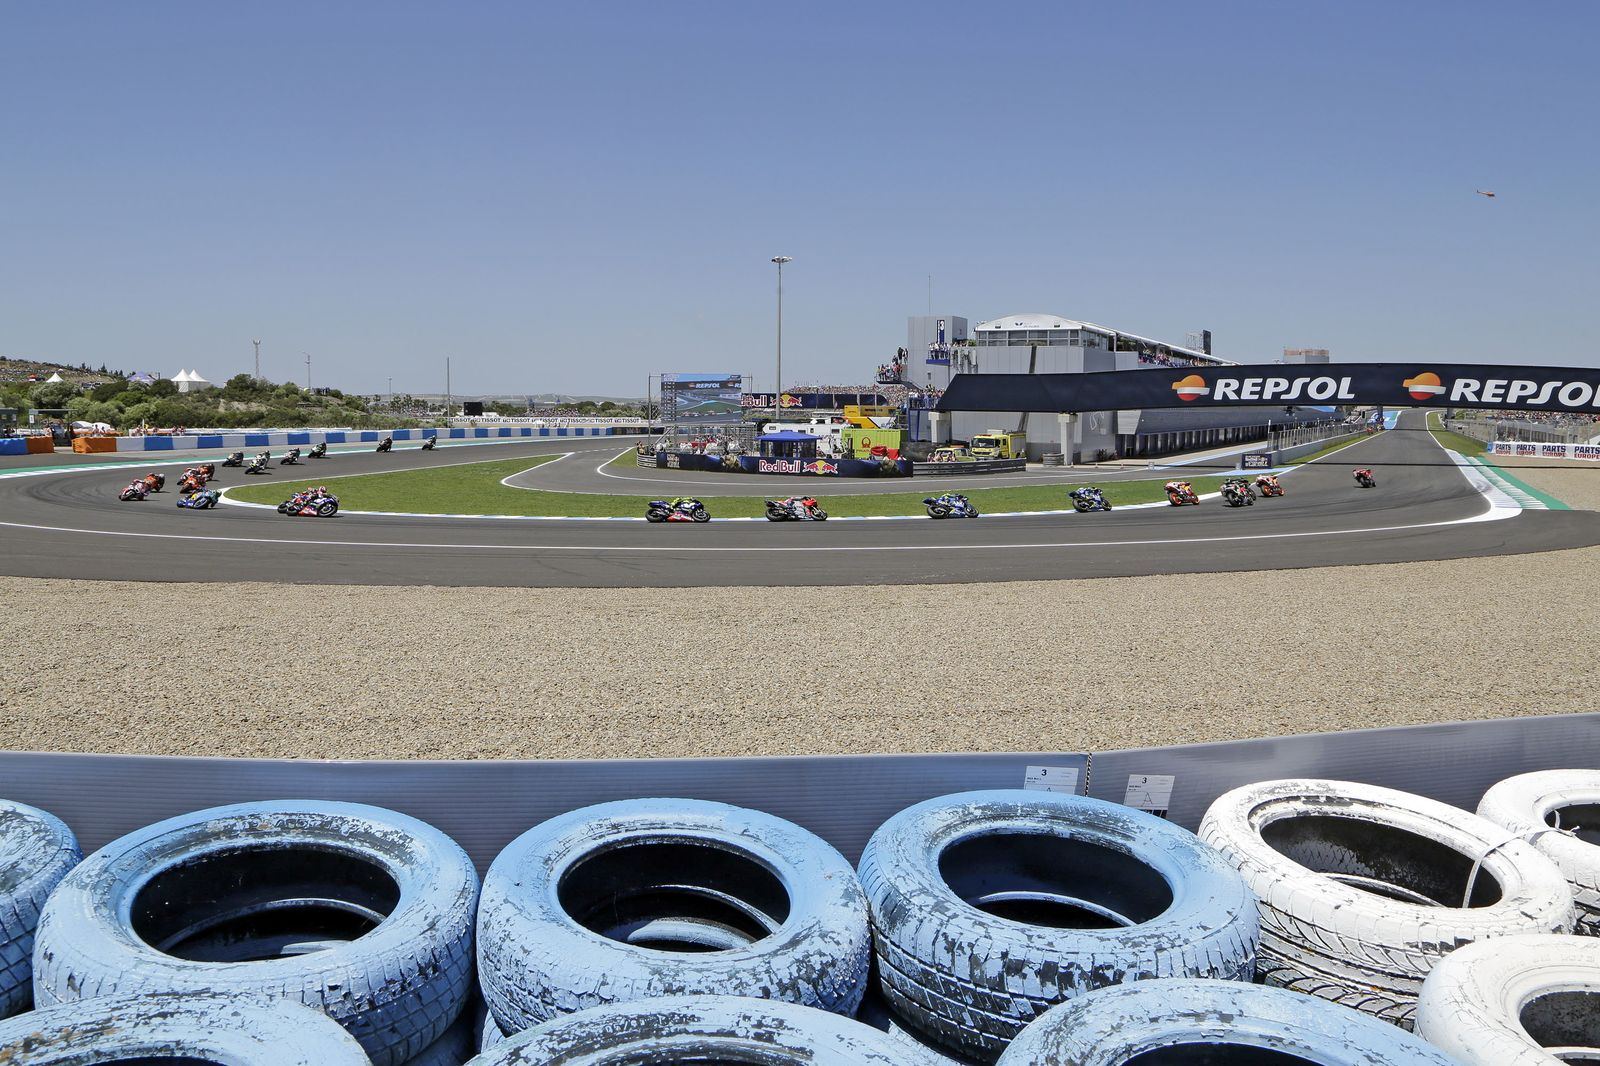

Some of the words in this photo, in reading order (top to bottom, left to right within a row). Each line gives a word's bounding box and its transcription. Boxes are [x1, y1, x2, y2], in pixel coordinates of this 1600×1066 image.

[1213, 376, 1355, 401] REPSOL
[1574, 446, 1600, 454] PARTS
[759, 460, 778, 472] Red
[780, 461, 800, 472] Bull
